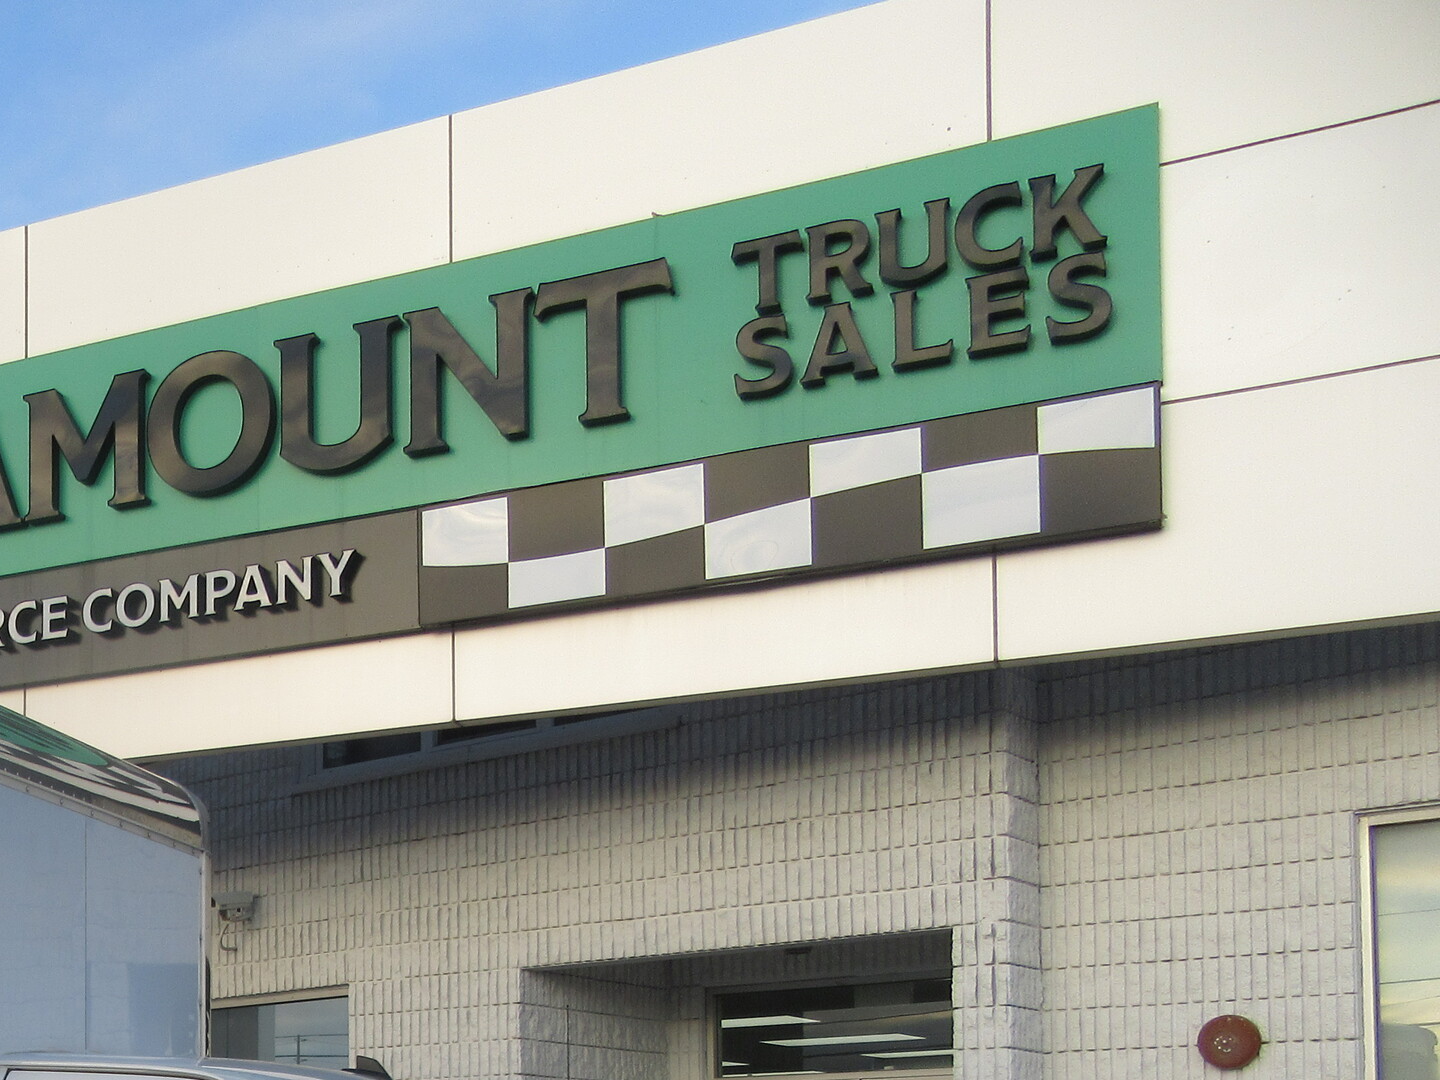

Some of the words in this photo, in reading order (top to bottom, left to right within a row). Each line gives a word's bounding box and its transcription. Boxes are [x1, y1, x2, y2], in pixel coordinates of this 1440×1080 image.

[730, 163, 1108, 314] TRUCK
[733, 250, 1113, 400] SALES
[81, 548, 358, 634] COMPANY
